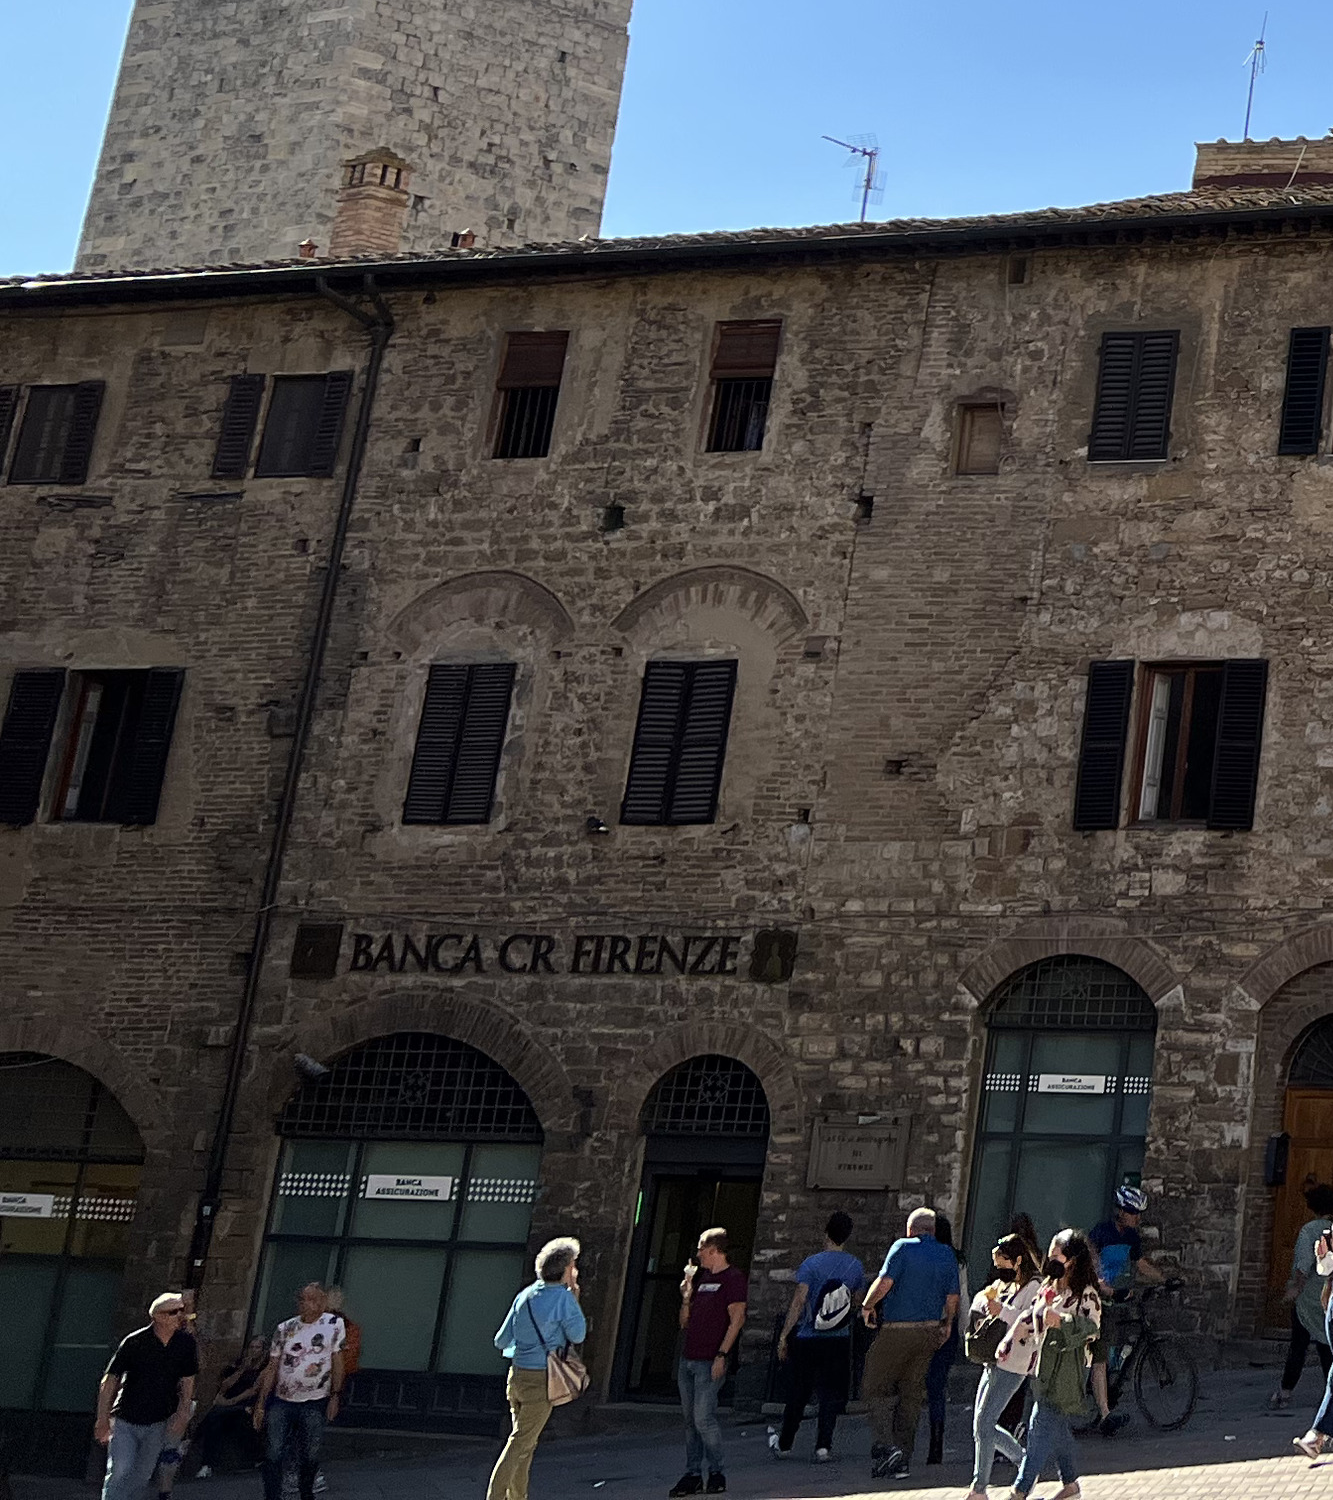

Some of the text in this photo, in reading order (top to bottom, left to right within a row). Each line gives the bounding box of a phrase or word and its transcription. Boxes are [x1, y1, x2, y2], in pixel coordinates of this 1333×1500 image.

[349, 933, 743, 975] BANCA CR FIRENZE
[395, 1178, 423, 1187] BANCA
[375, 1187, 440, 1198] ASSICURAZIONE
